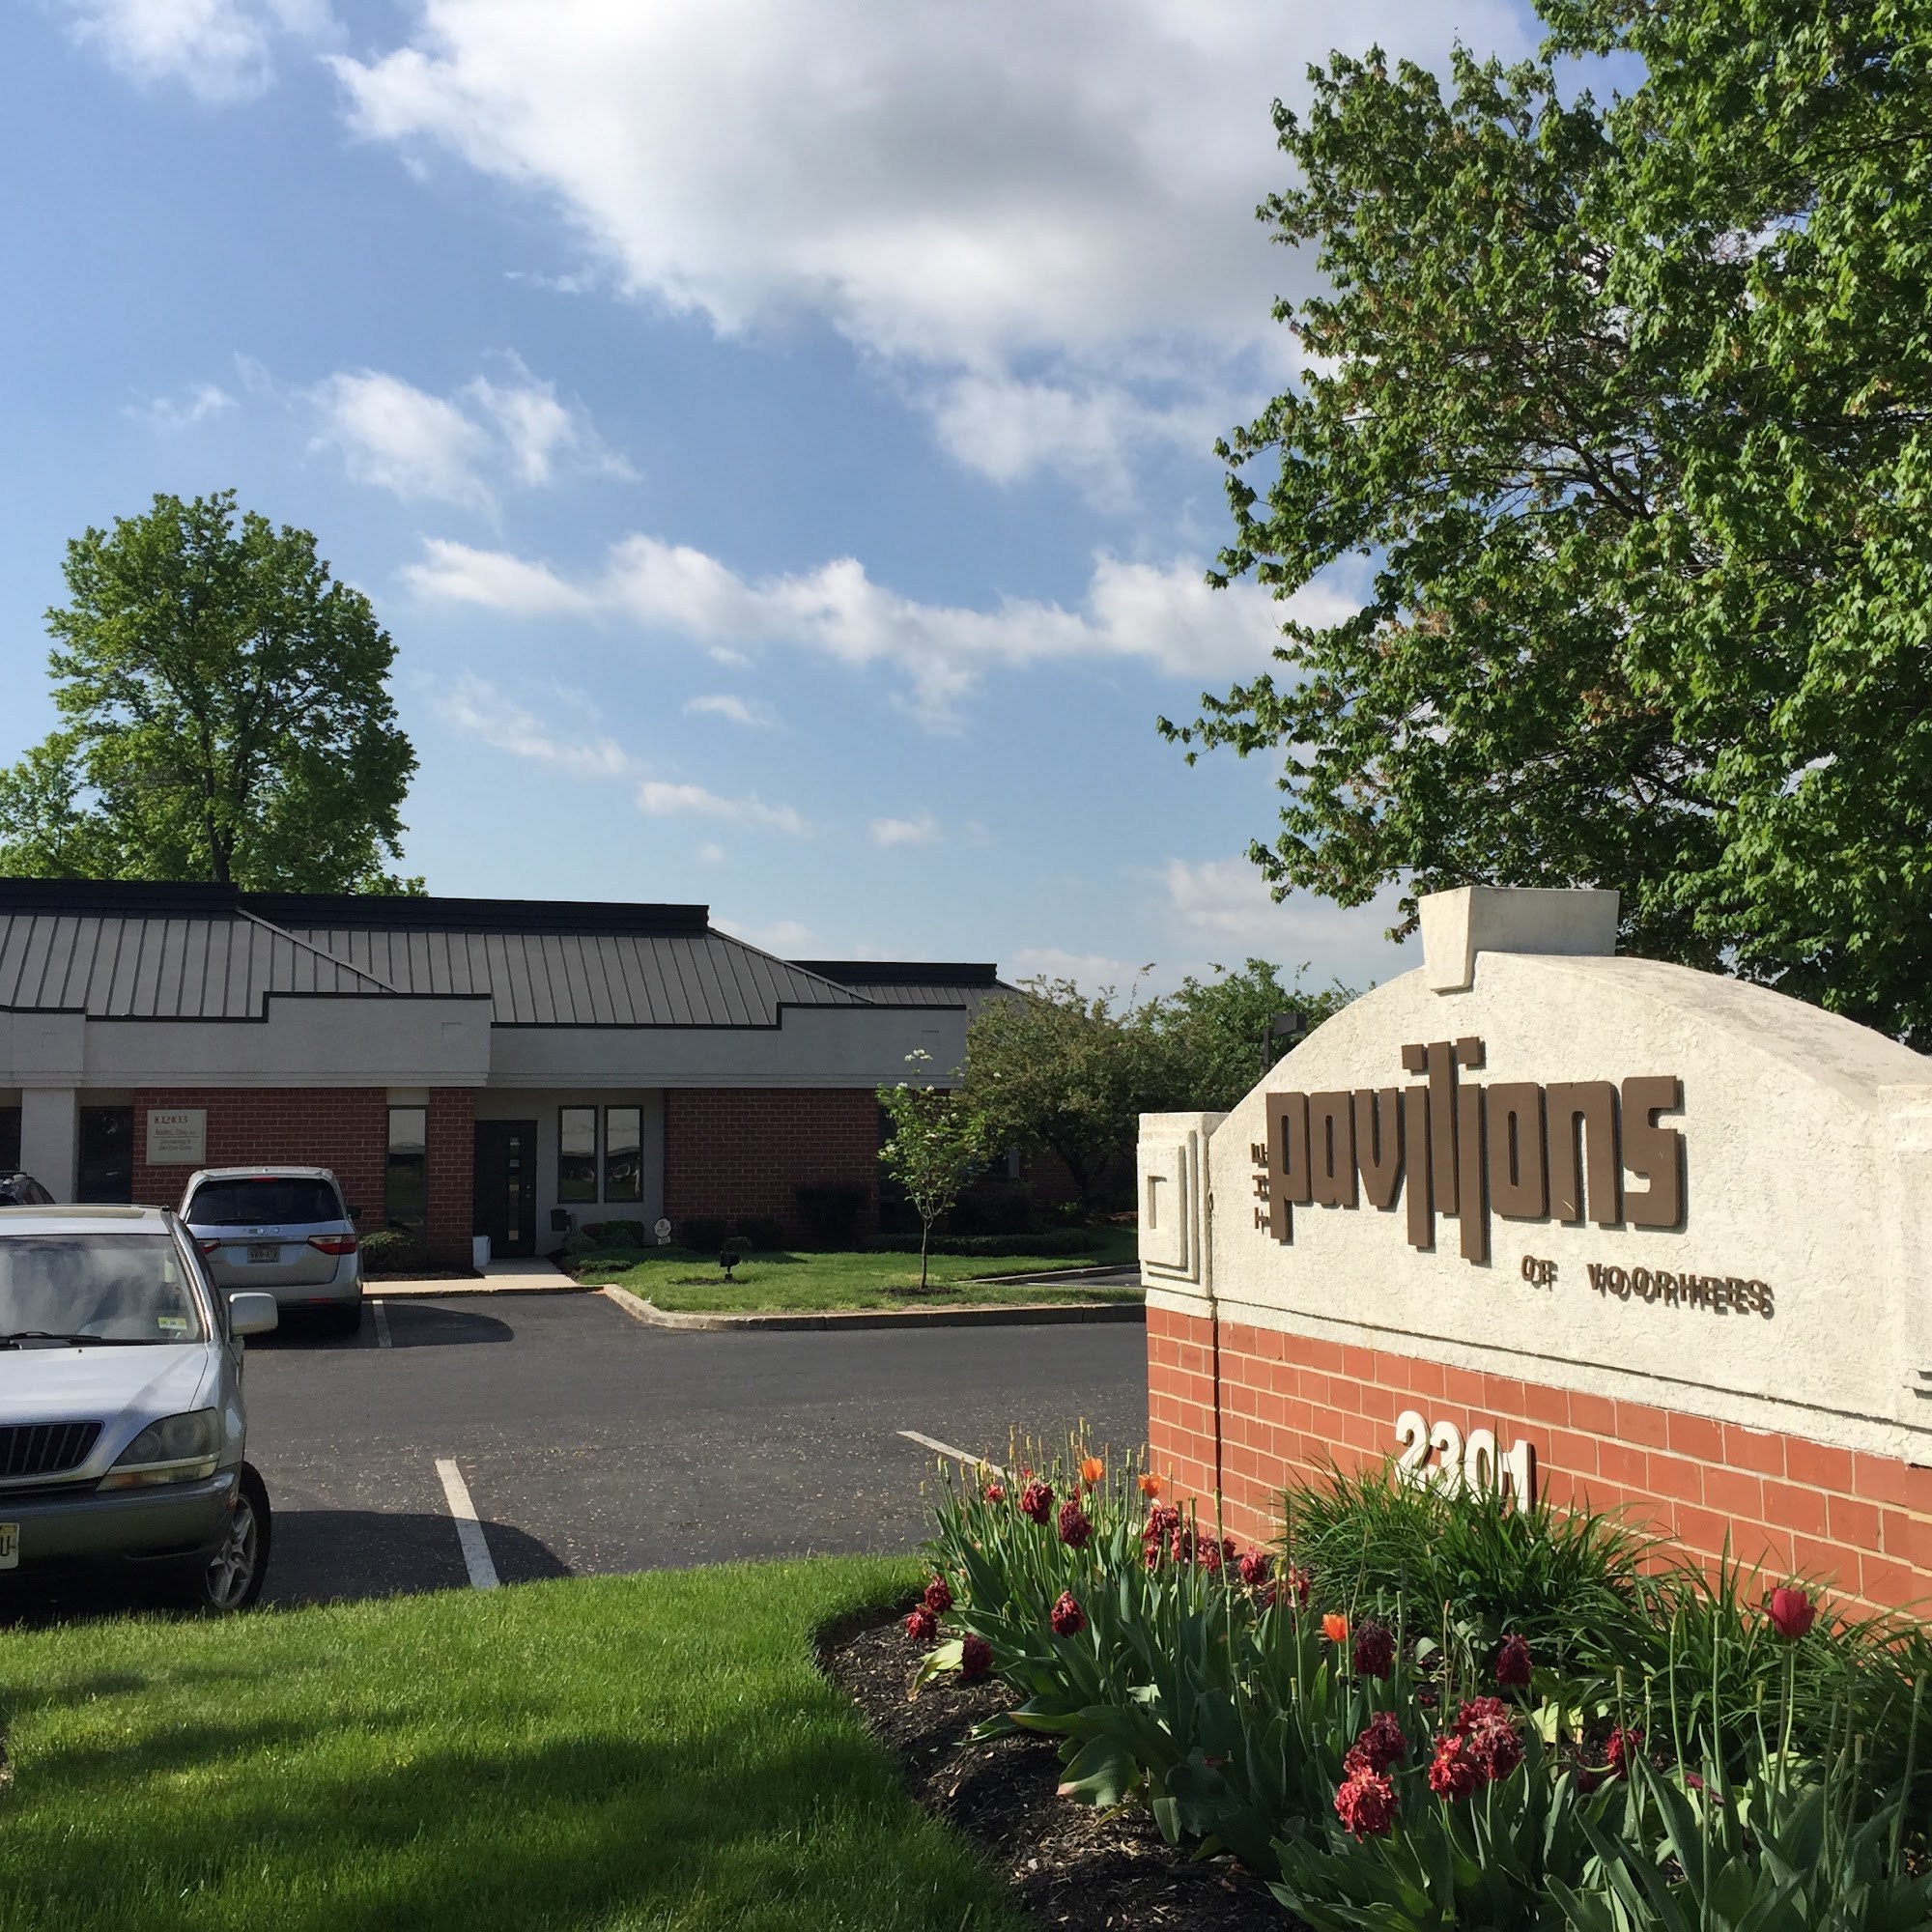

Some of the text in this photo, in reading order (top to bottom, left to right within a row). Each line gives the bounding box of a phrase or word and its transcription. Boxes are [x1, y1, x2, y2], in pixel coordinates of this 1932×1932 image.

[1251, 1143, 1269, 1230] THE
[1520, 1254, 1769, 1313] OF VOORHEES
[1395, 1409, 1534, 1517] 2301
